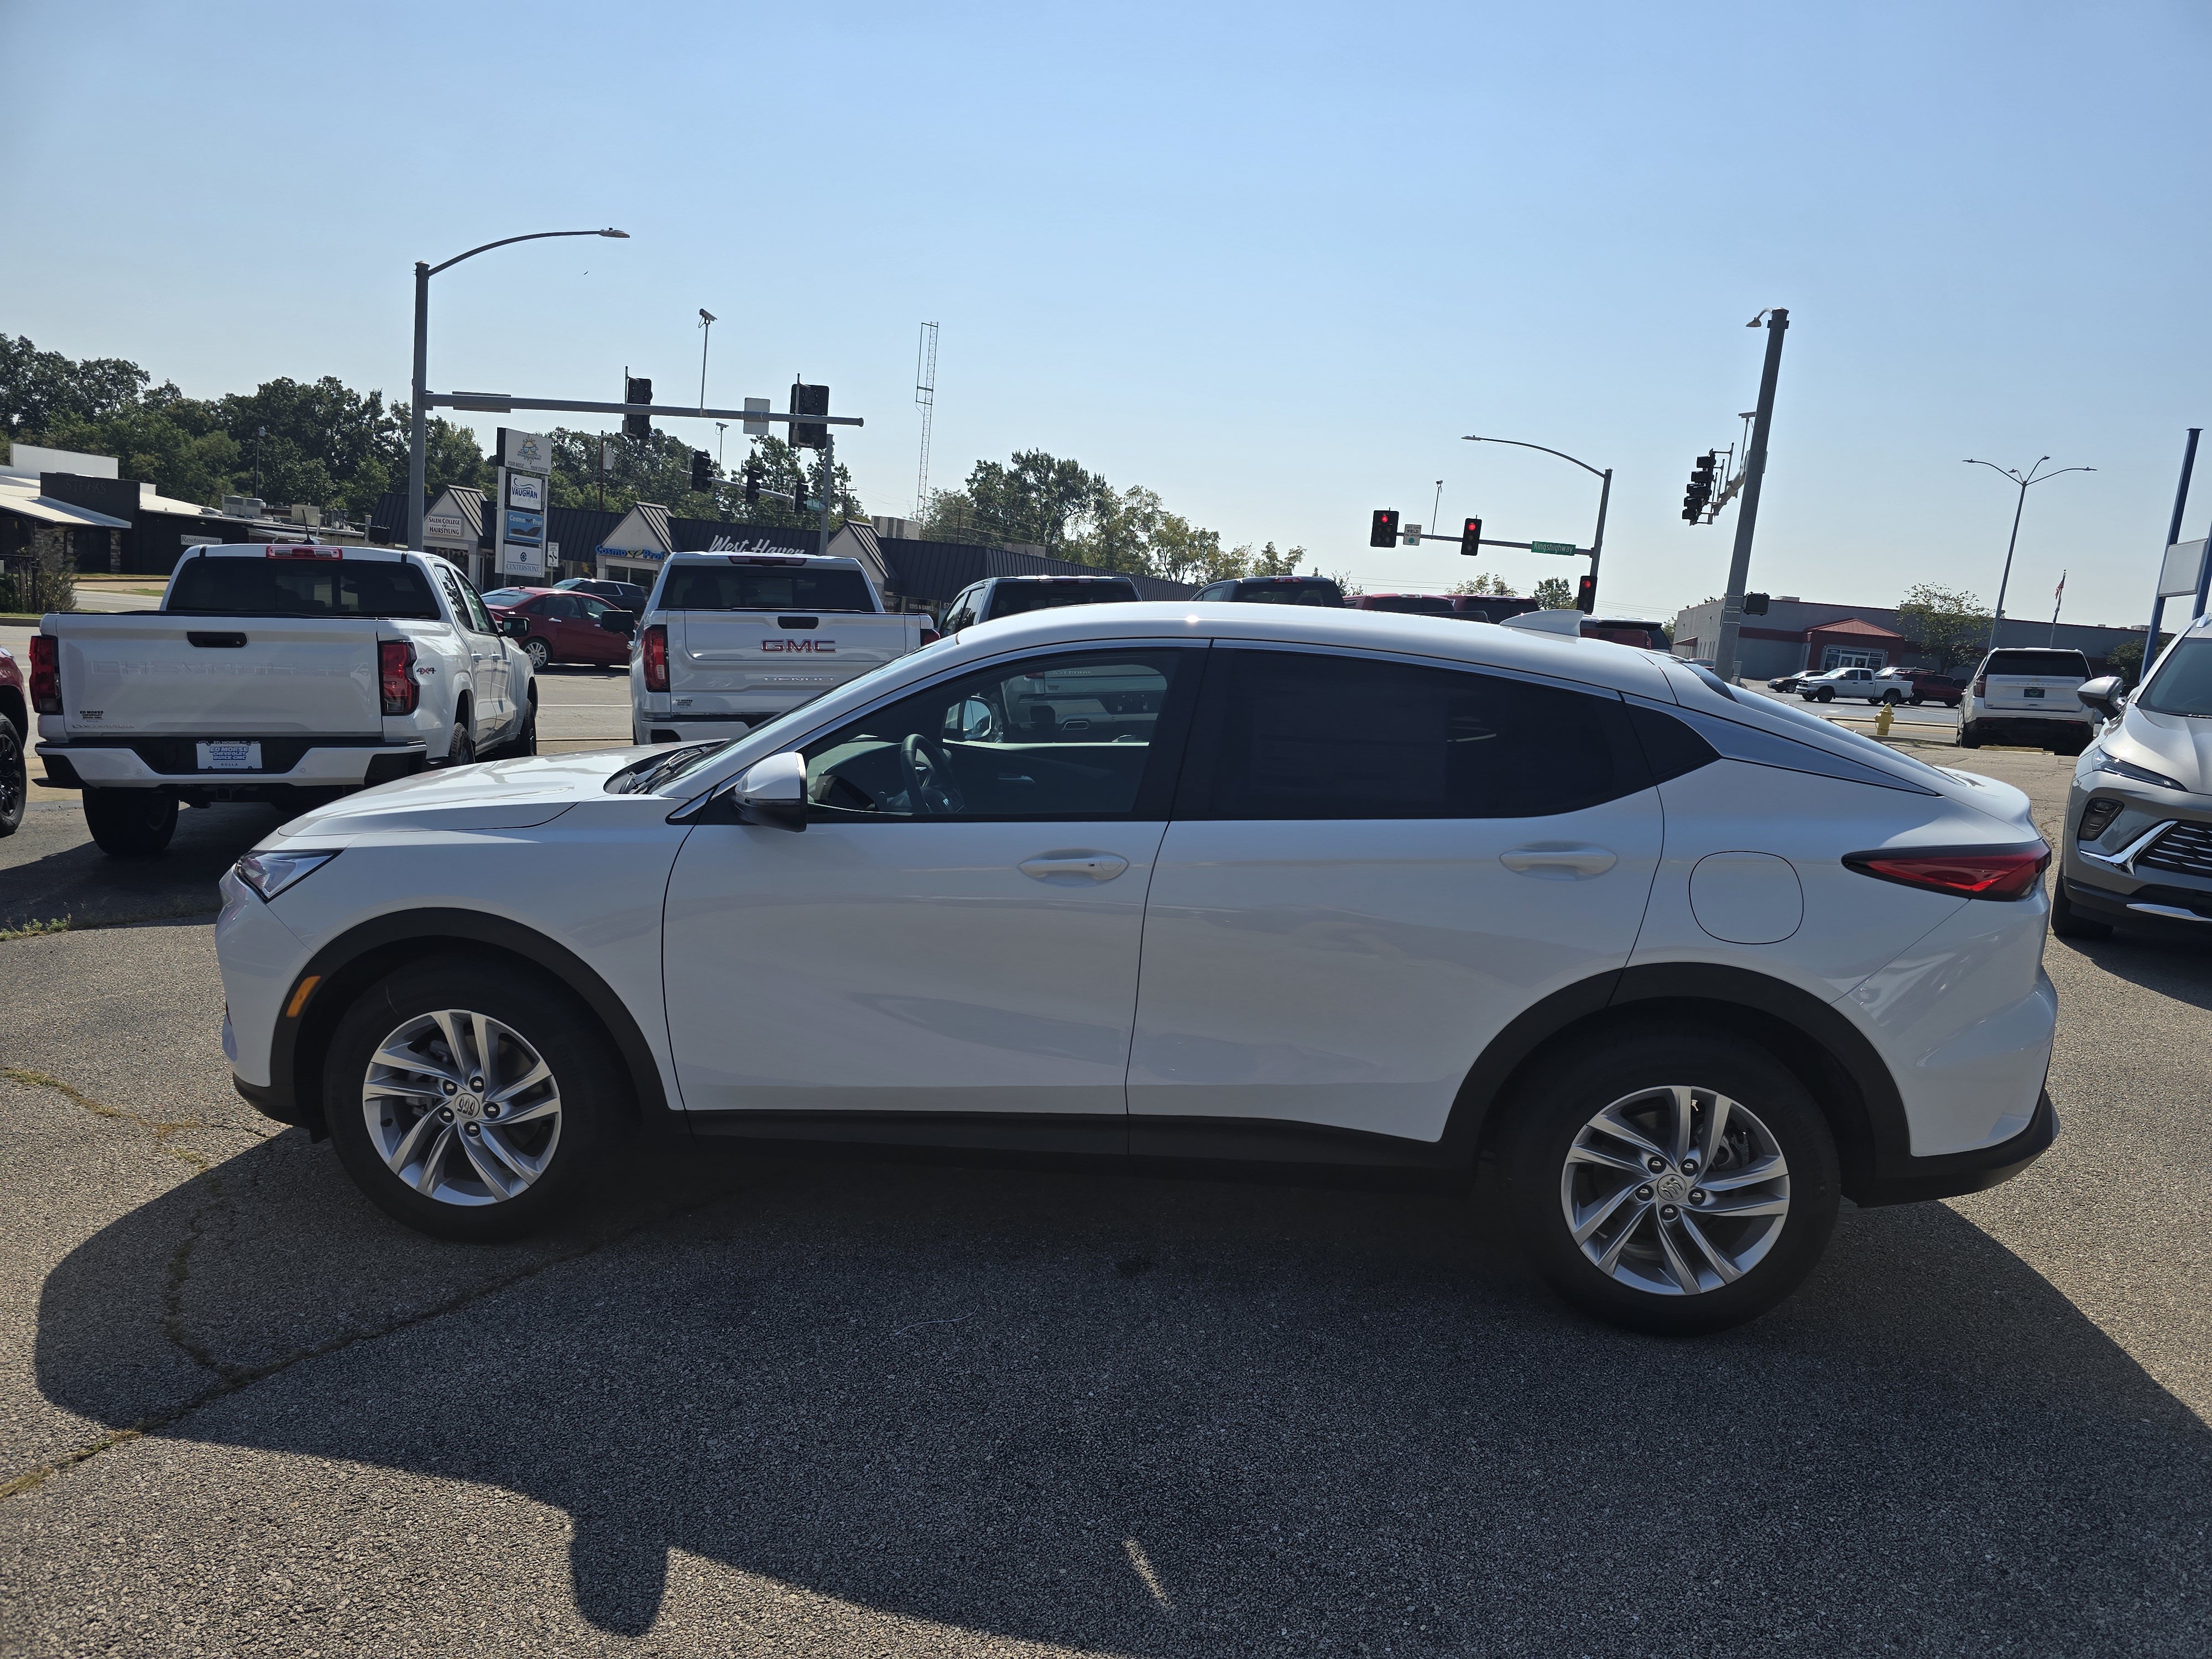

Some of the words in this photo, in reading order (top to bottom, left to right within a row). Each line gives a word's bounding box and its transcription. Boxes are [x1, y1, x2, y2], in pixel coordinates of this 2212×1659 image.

[512, 487, 538, 499] VAUGHAN
[509, 515, 526, 523] Cosmo
[430, 526, 460, 535] HAIRSTYLING
[708, 535, 750, 553] West
[751, 539, 805, 555] Haven
[1533, 542, 1574, 555] Kingshighway
[595, 544, 628, 557] Cosmo
[642, 549, 666, 561] Prof
[506, 564, 540, 573] CENTERSTONE
[761, 639, 837, 653] GMC
